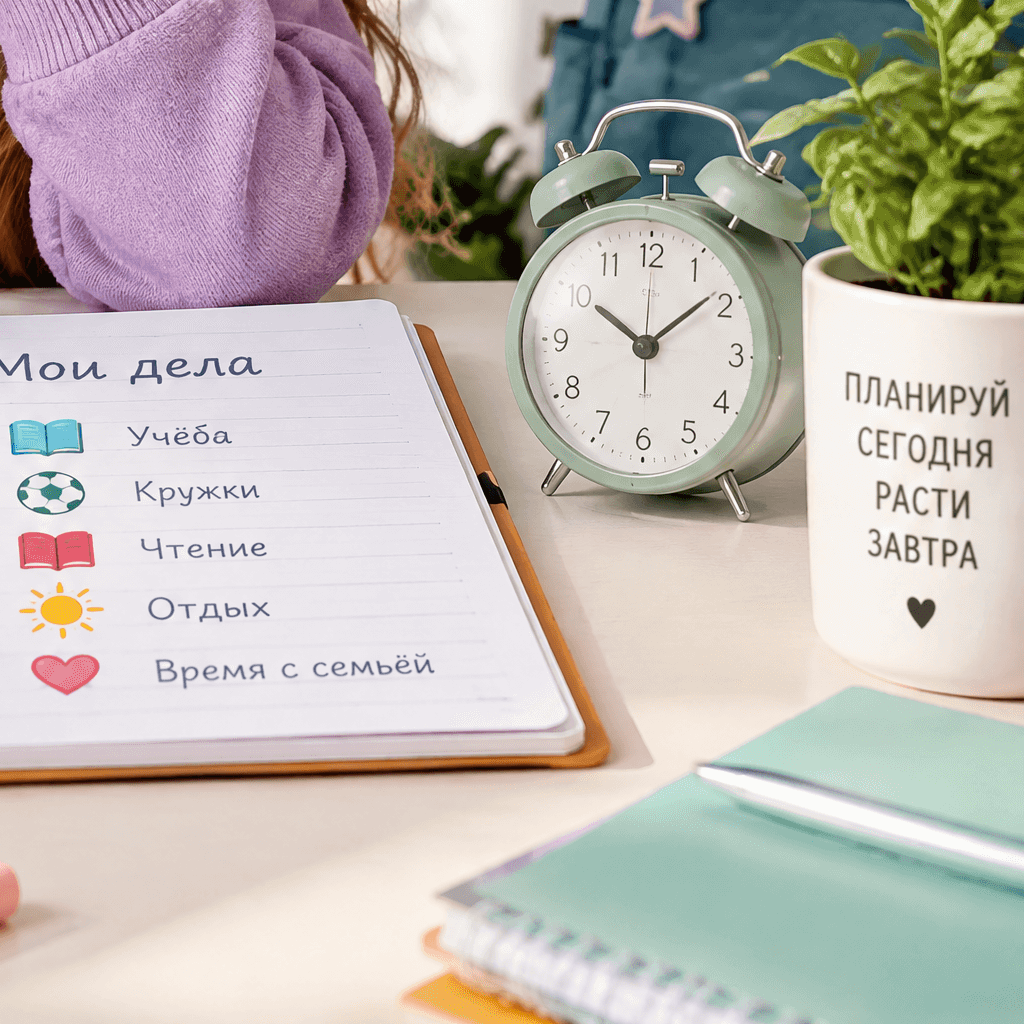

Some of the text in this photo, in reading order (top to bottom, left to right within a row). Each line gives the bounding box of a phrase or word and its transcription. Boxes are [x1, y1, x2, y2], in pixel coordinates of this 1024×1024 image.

[600, 251, 618, 277] 11
[639, 242, 664, 269] 12
[691, 257, 698, 283] 1
[568, 283, 592, 308] 10
[717, 292, 733, 319] 2
[553, 328, 569, 353] 9
[728, 342, 744, 368] 3
[129, 356, 263, 386] дела
[564, 375, 580, 400] 8
[845, 371, 1010, 418] ПЛАНИРУЙ
[712, 389, 730, 415] 4
[126, 423, 233, 447] Учёба
[595, 409, 611, 435] 7
[681, 419, 697, 444] 5
[635, 427, 652, 451] 6
[857, 426, 993, 472] СЕГОДНЯ
[134, 480, 260, 508] Кружки
[876, 480, 971, 520] РАСТИ
[140, 537, 268, 560] Чтение
[867, 528, 979, 571] ЗАВТРА
[147, 596, 271, 623] Отдых
[155, 652, 435, 690] Время с семьёй
